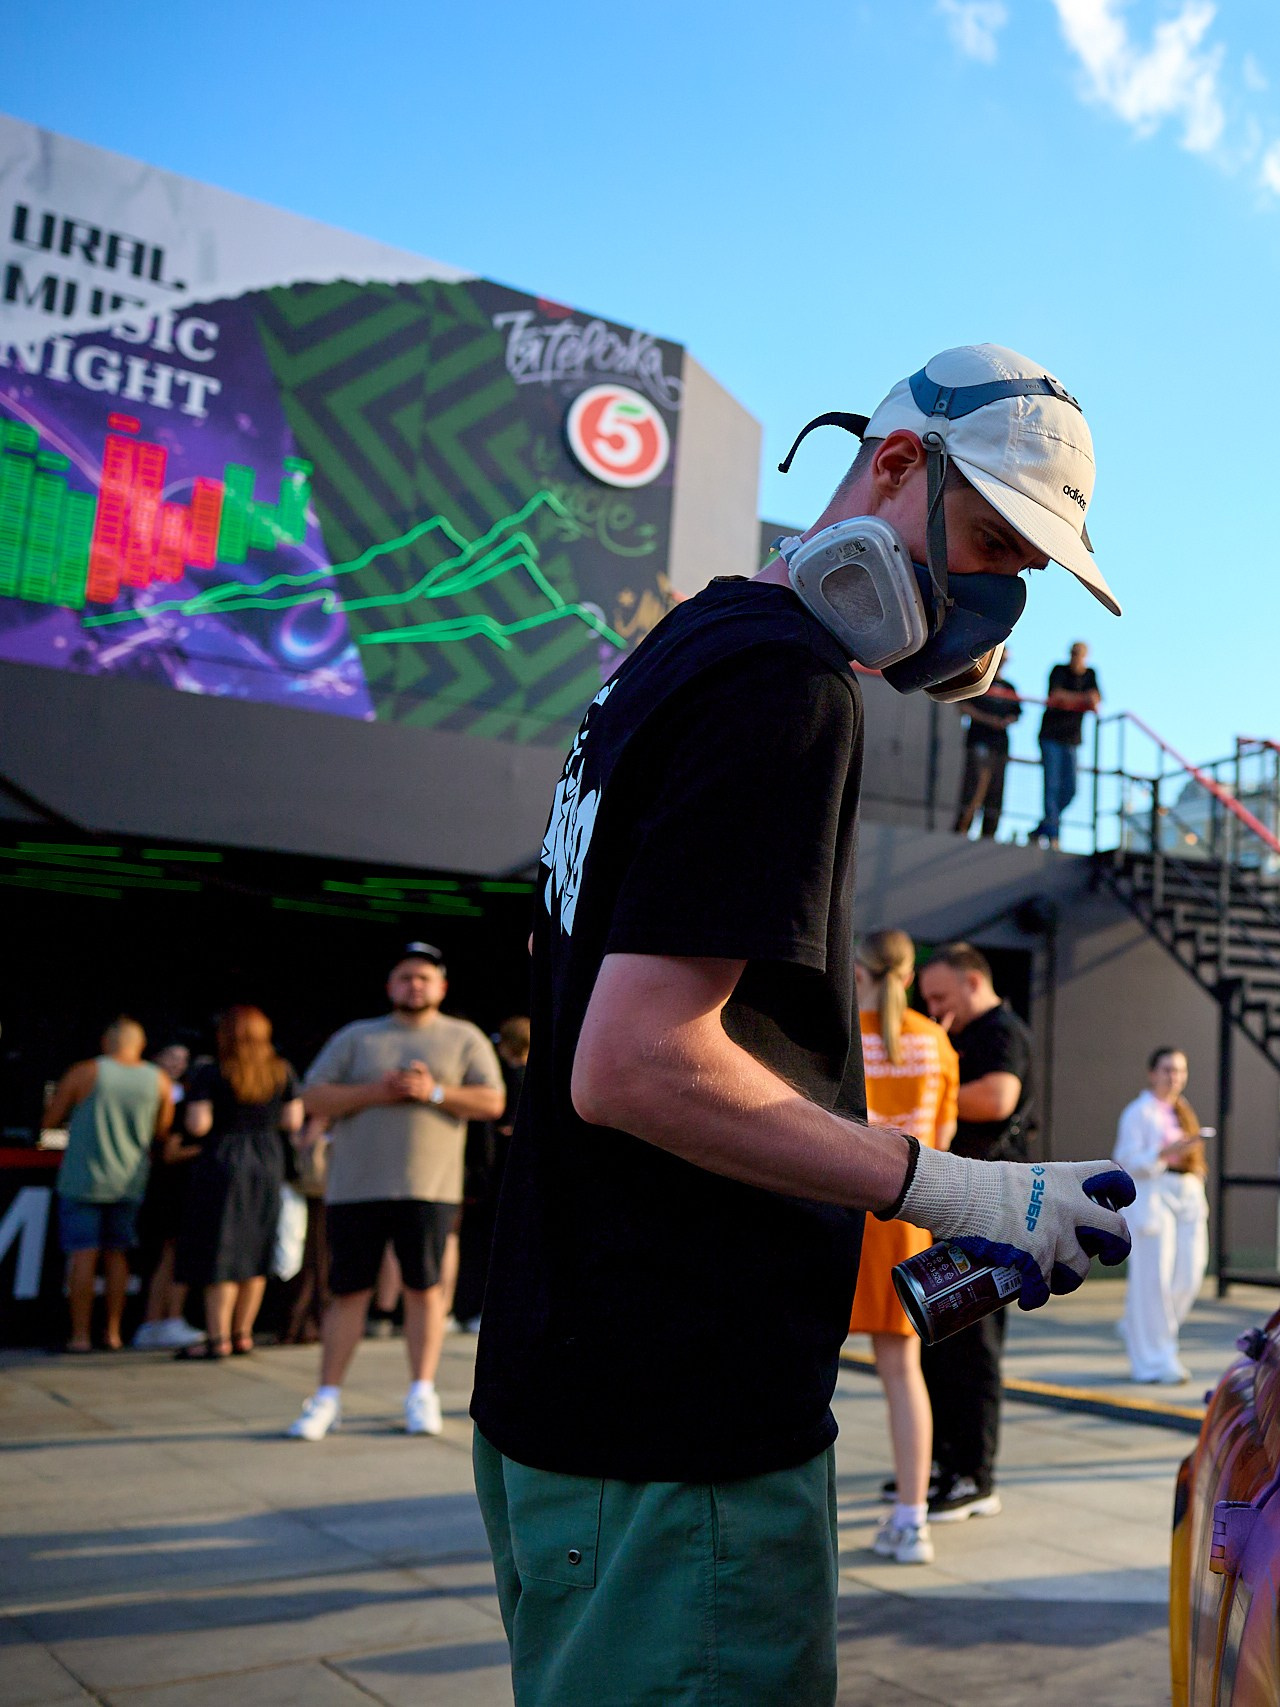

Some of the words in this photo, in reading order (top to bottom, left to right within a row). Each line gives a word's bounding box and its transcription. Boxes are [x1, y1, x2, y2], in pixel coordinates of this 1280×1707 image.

[12, 203, 187, 291] URAL
[4, 263, 219, 362] MUSIC
[0, 333, 222, 418] NIGHT
